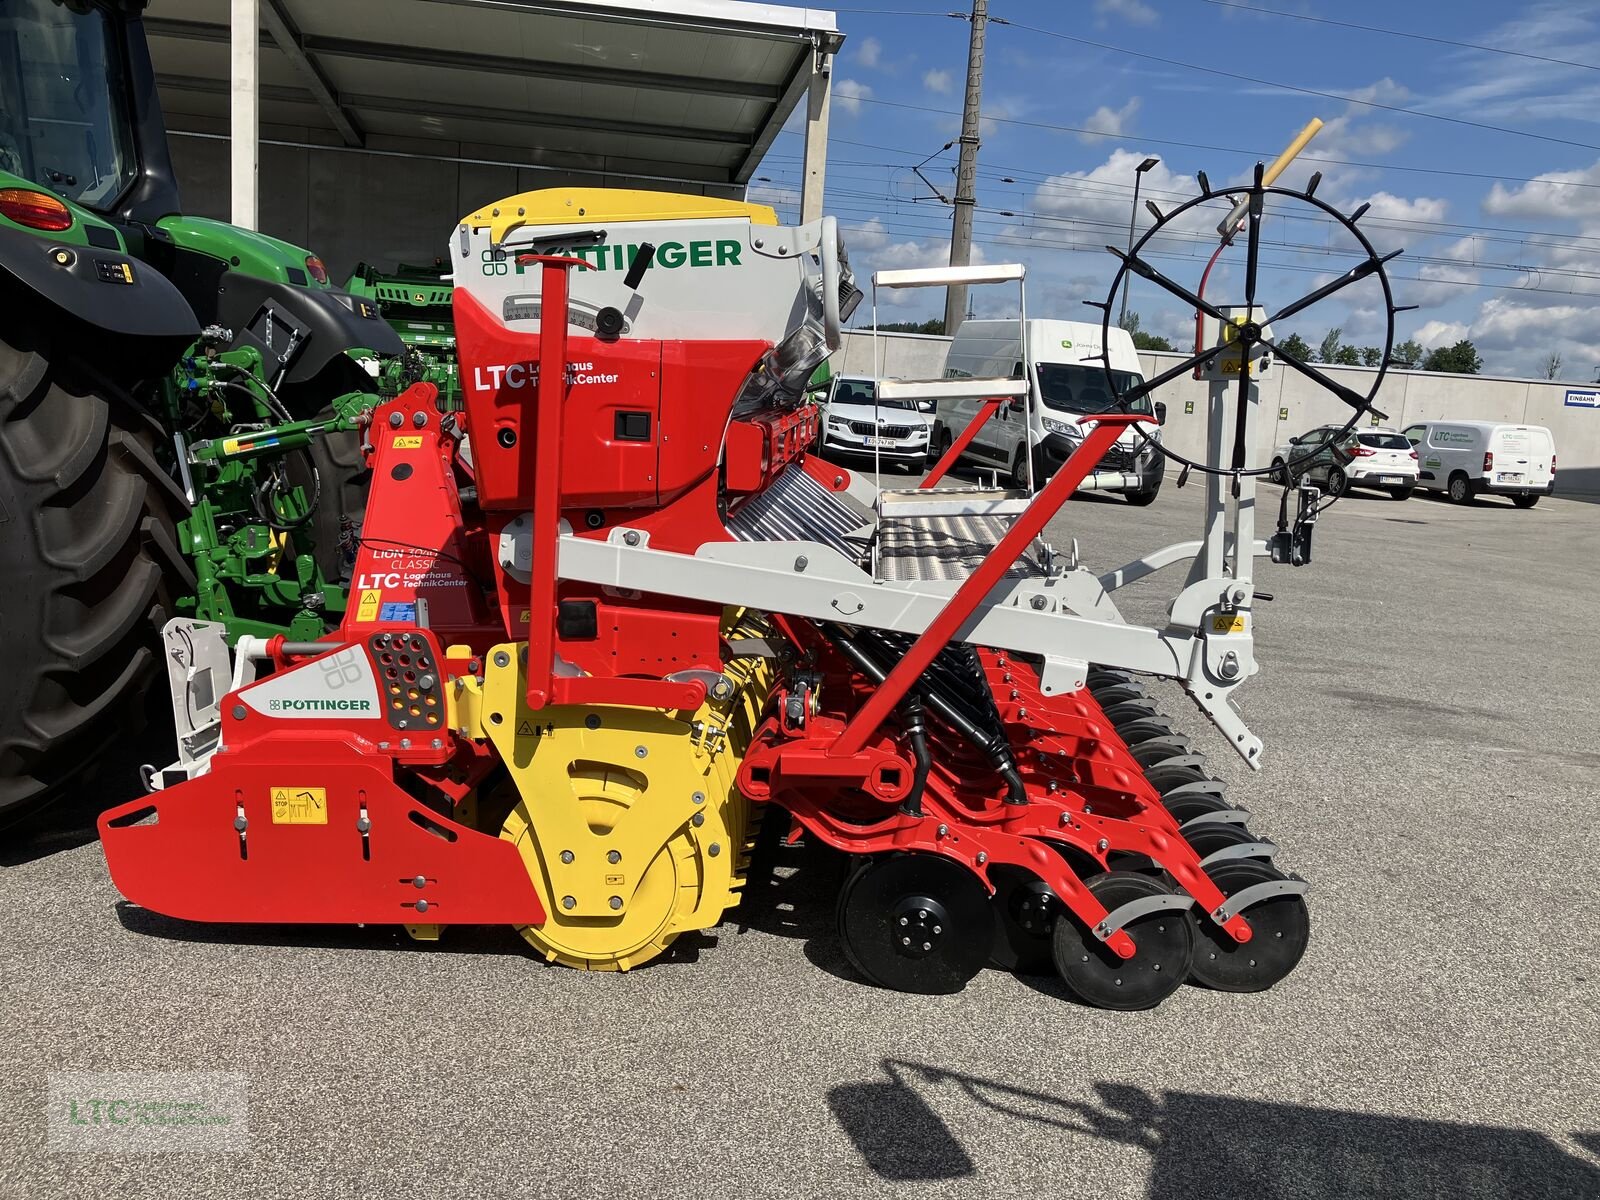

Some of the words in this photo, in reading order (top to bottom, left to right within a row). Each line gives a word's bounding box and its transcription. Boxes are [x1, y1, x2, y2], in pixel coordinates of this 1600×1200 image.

[474, 364, 526, 390] LTC
[1434, 431, 1450, 441] LTC
[372, 549, 404, 558] LION
[391, 560, 440, 570] CLASSIC
[358, 573, 400, 589] LTC
[404, 572, 452, 580] Lagerhaus
[403, 580, 468, 588] TechnikCenter
[282, 700, 370, 710] PÖTTINGER
